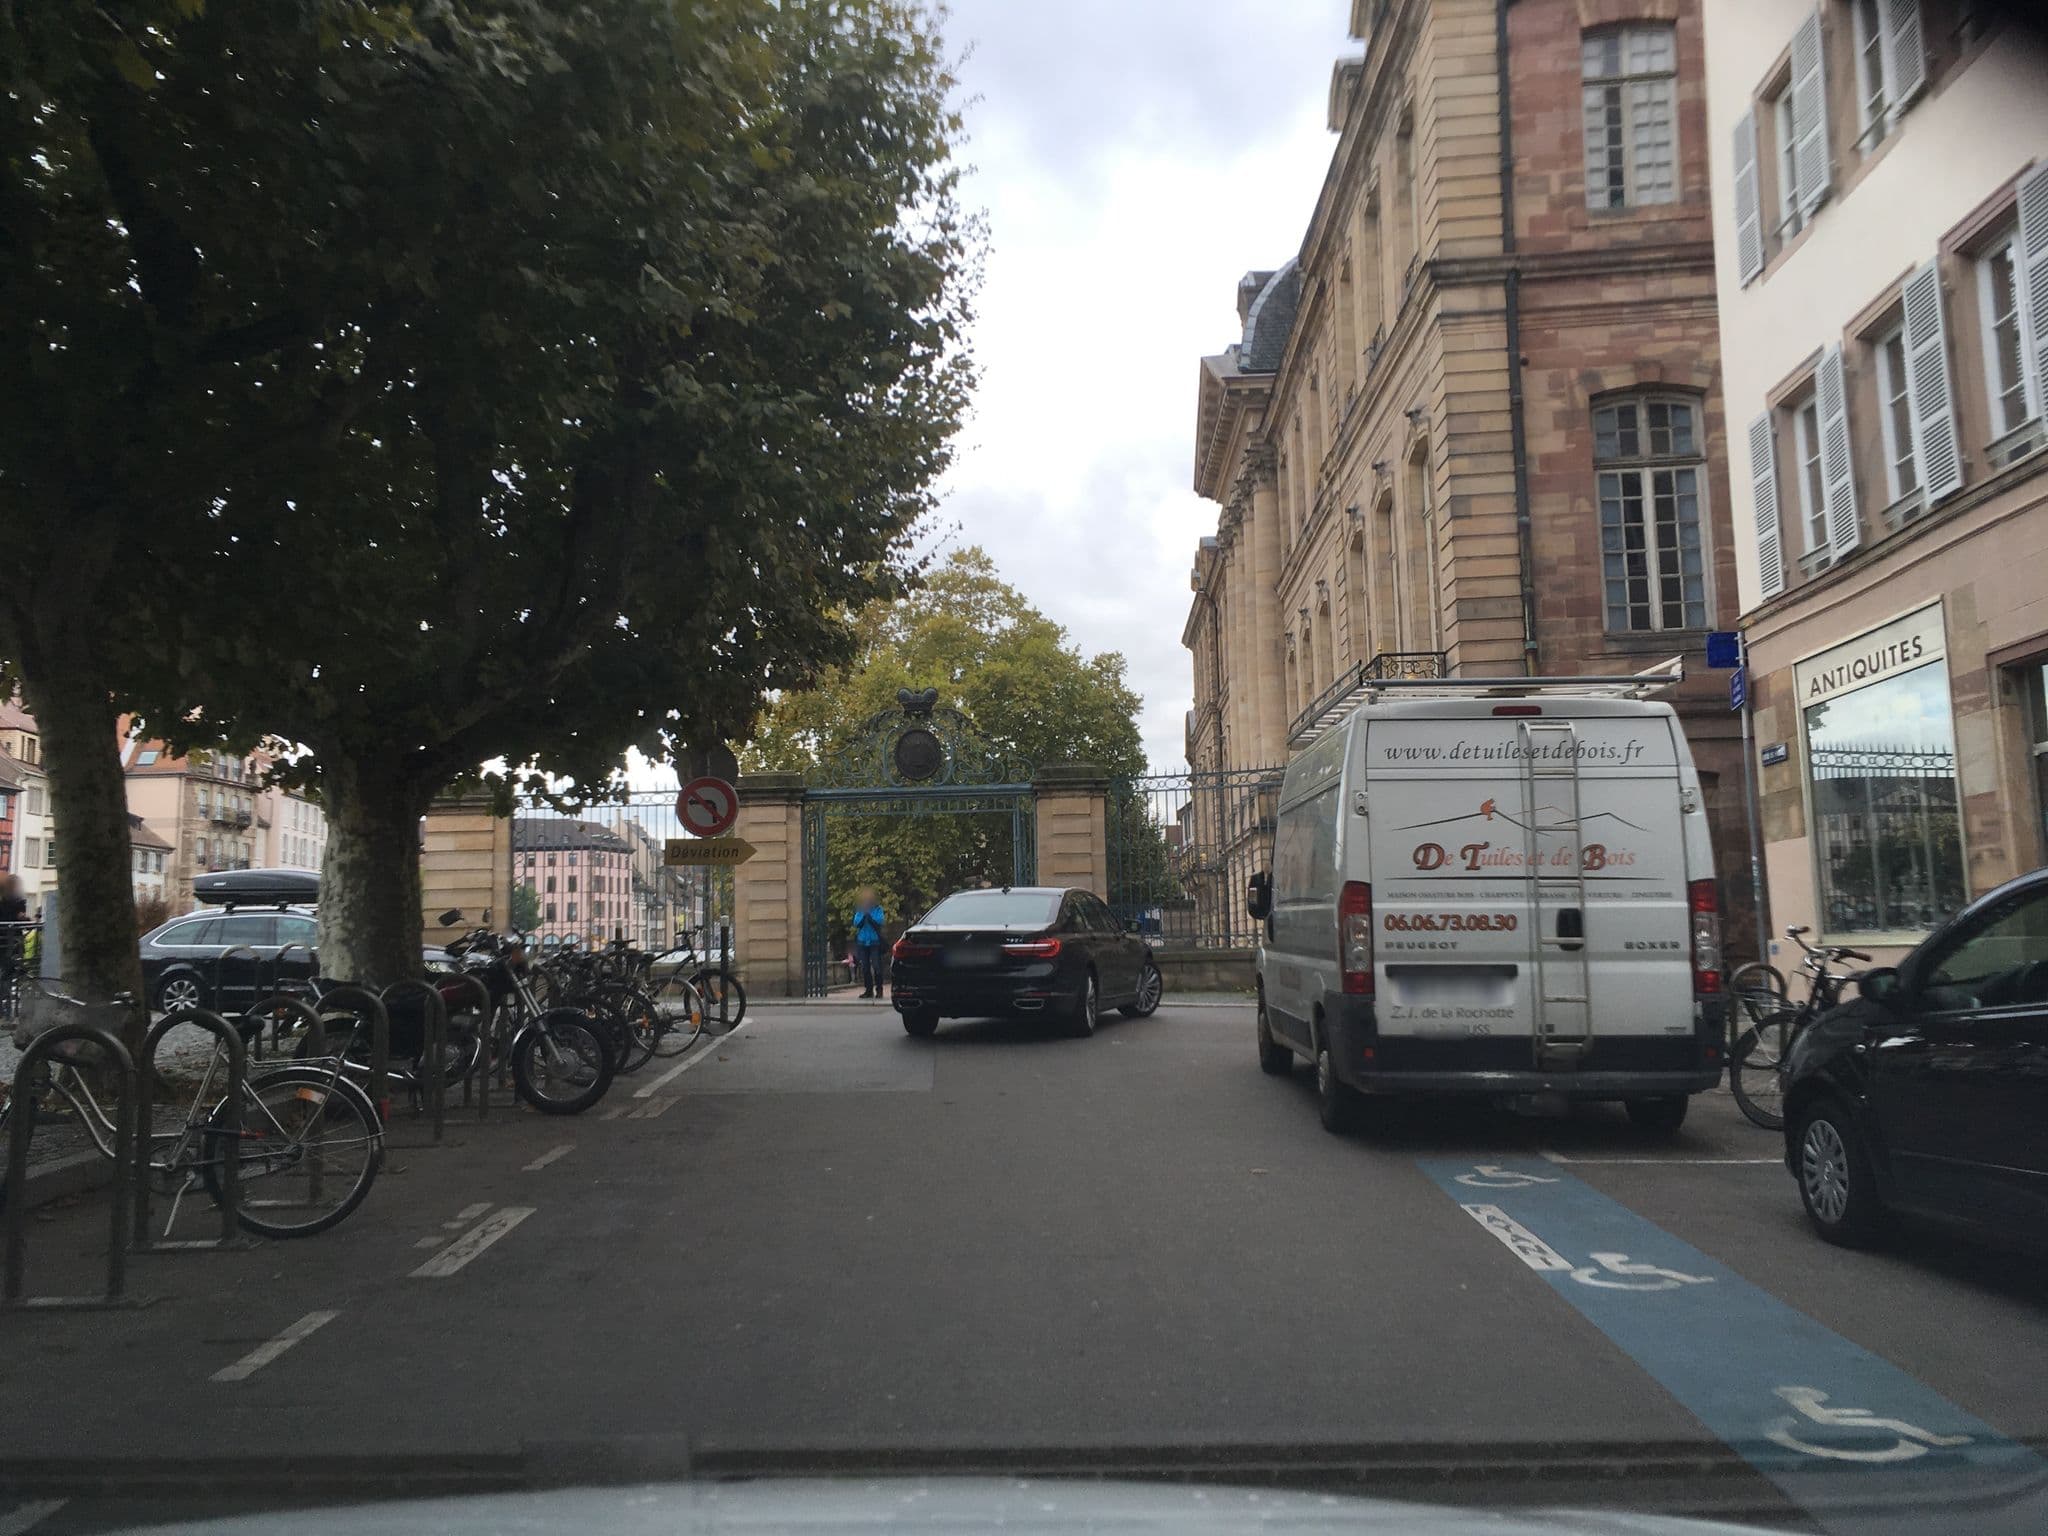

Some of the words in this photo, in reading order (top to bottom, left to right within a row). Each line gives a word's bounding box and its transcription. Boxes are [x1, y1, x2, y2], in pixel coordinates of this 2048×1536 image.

[1810, 635, 1923, 698] ANTIQUITES
[1384, 740, 1644, 765] www.detuilesetdebois.fr
[1412, 842, 1453, 870] De
[1460, 841, 1523, 870] Tuiles
[1527, 850, 1545, 866] et
[1551, 846, 1573, 866] de
[1581, 843, 1635, 871] Bois
[1383, 914, 1518, 931] 06.06.73.08.30
[1384, 941, 1459, 950] PEUGEOT
[1623, 941, 1681, 950] BOXER
[1421, 1007, 1438, 1019] de
